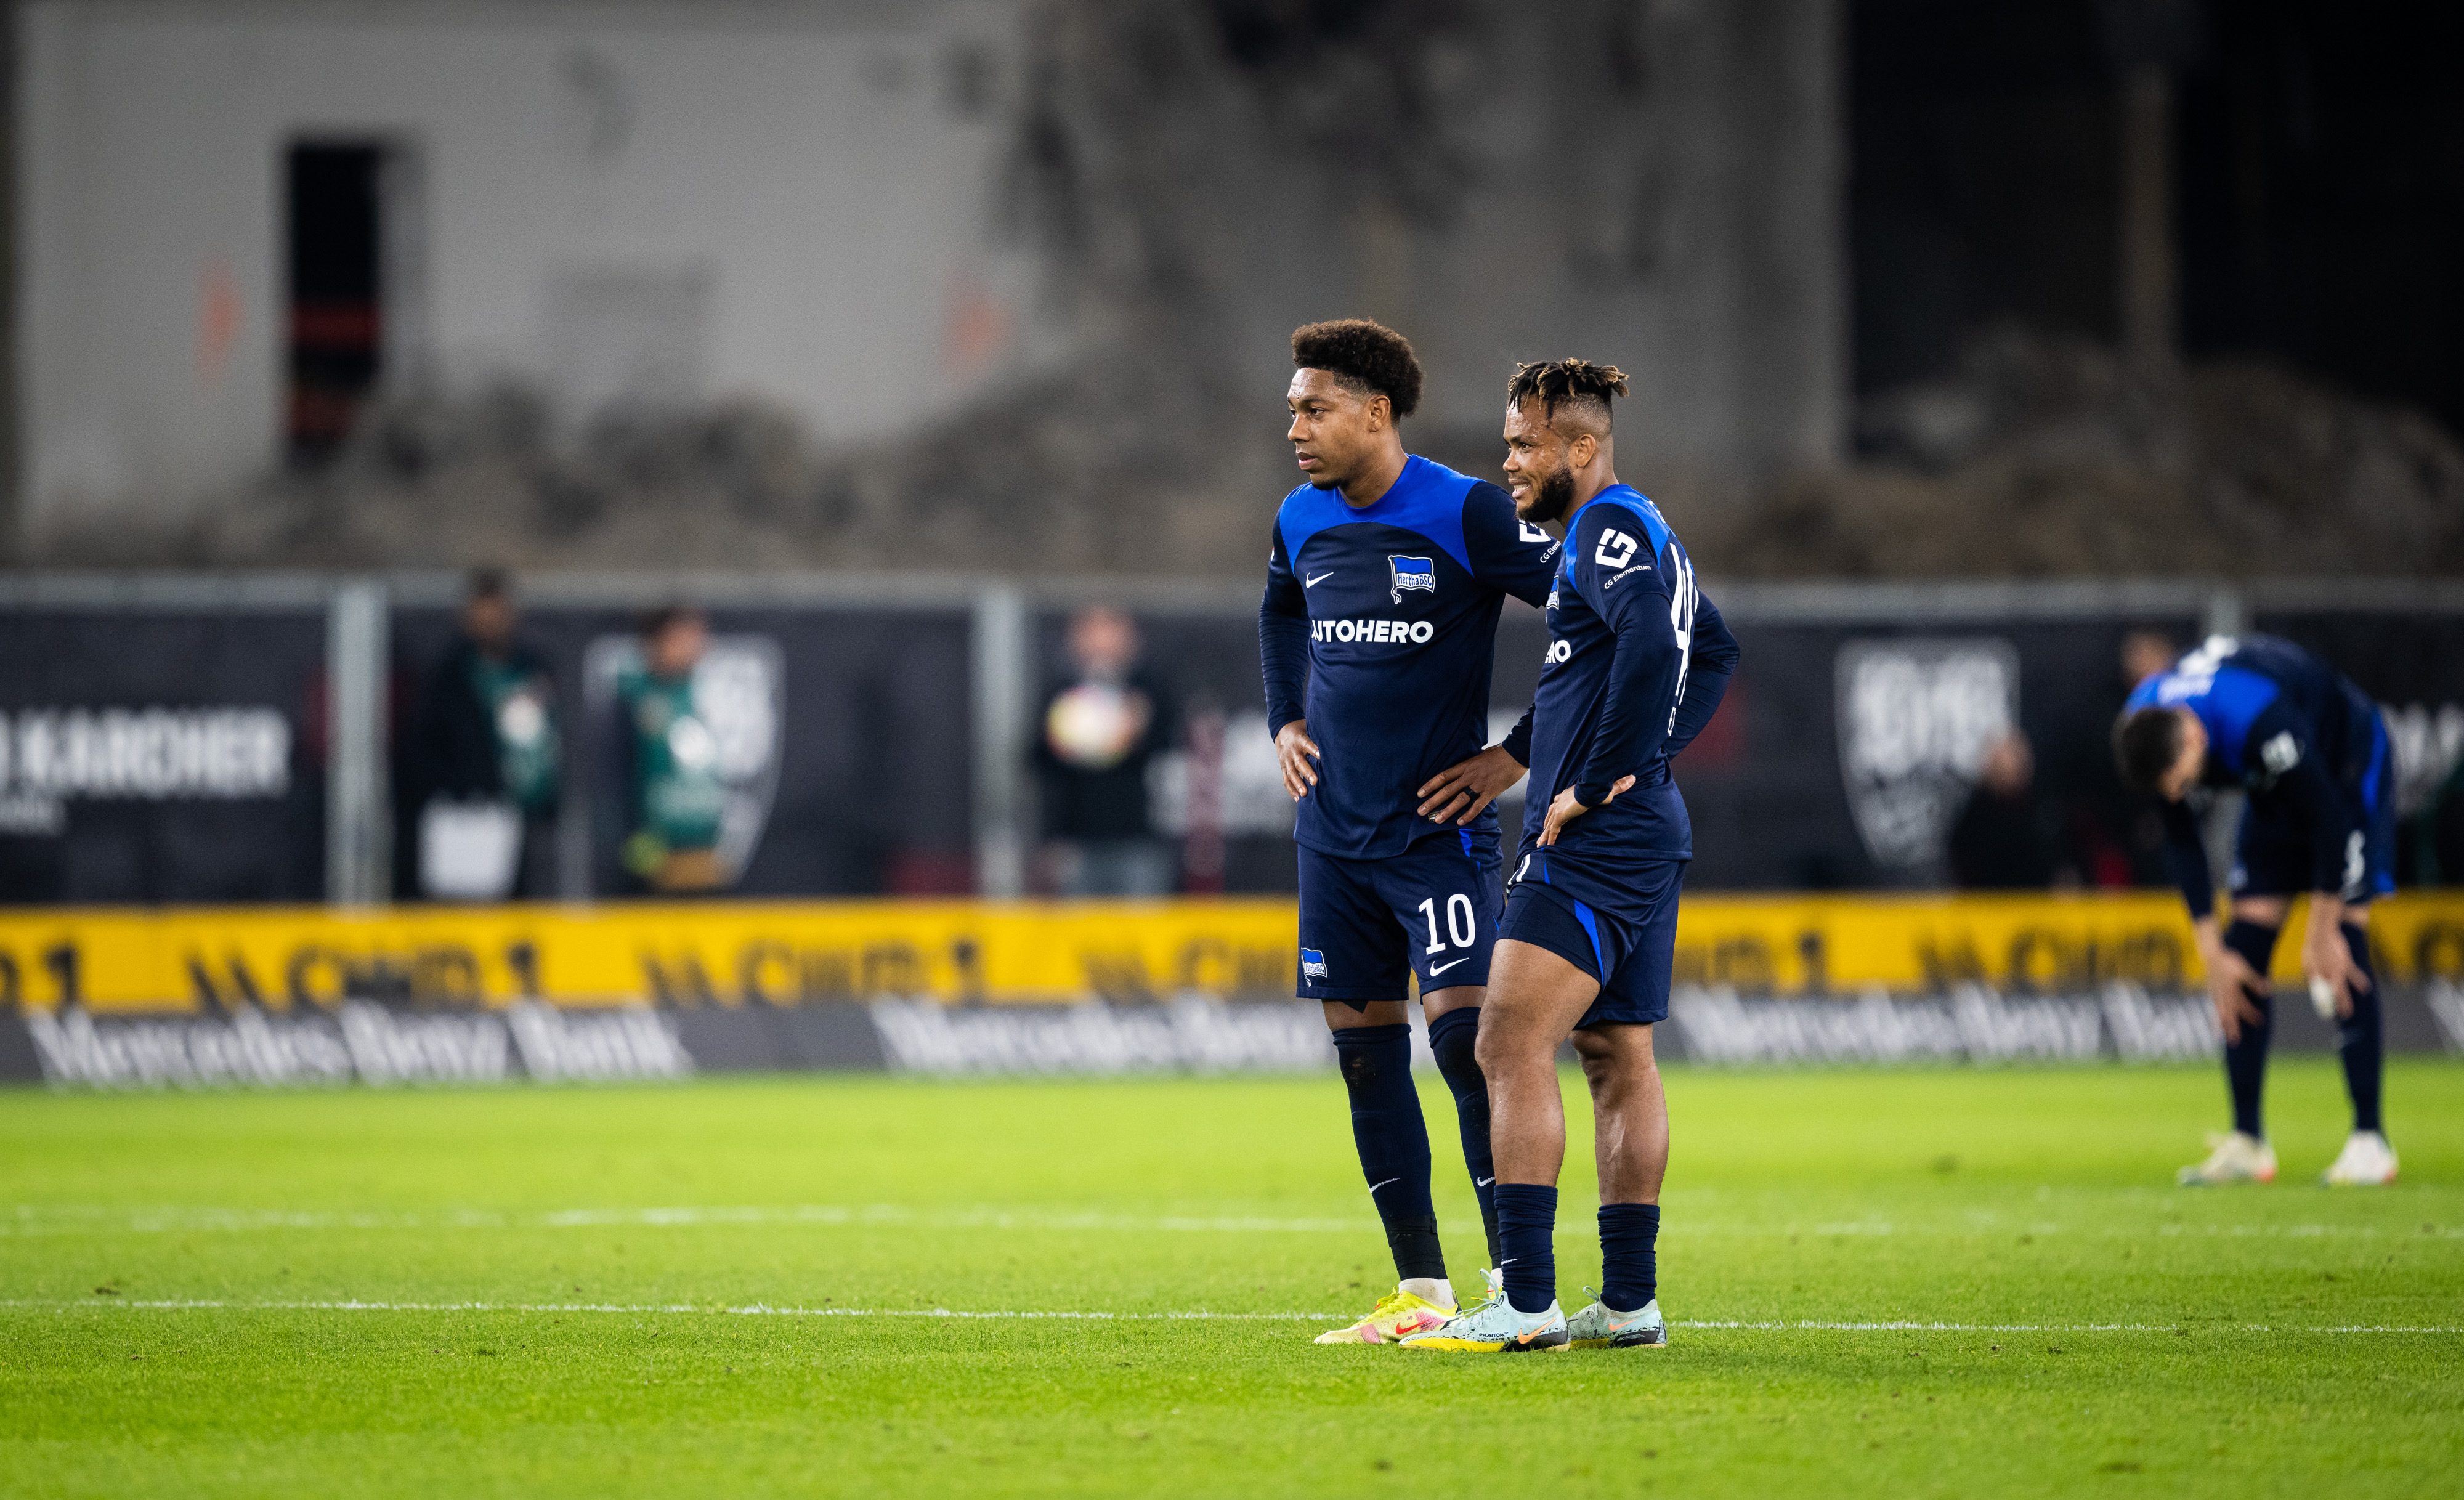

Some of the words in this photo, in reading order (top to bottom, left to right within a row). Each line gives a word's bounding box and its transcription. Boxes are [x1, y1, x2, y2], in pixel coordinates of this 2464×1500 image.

[1540, 553, 1550, 564] CG
[1604, 579, 1613, 590] CG
[1613, 565, 1652, 582] Elementum
[1419, 893, 1476, 955] 10
